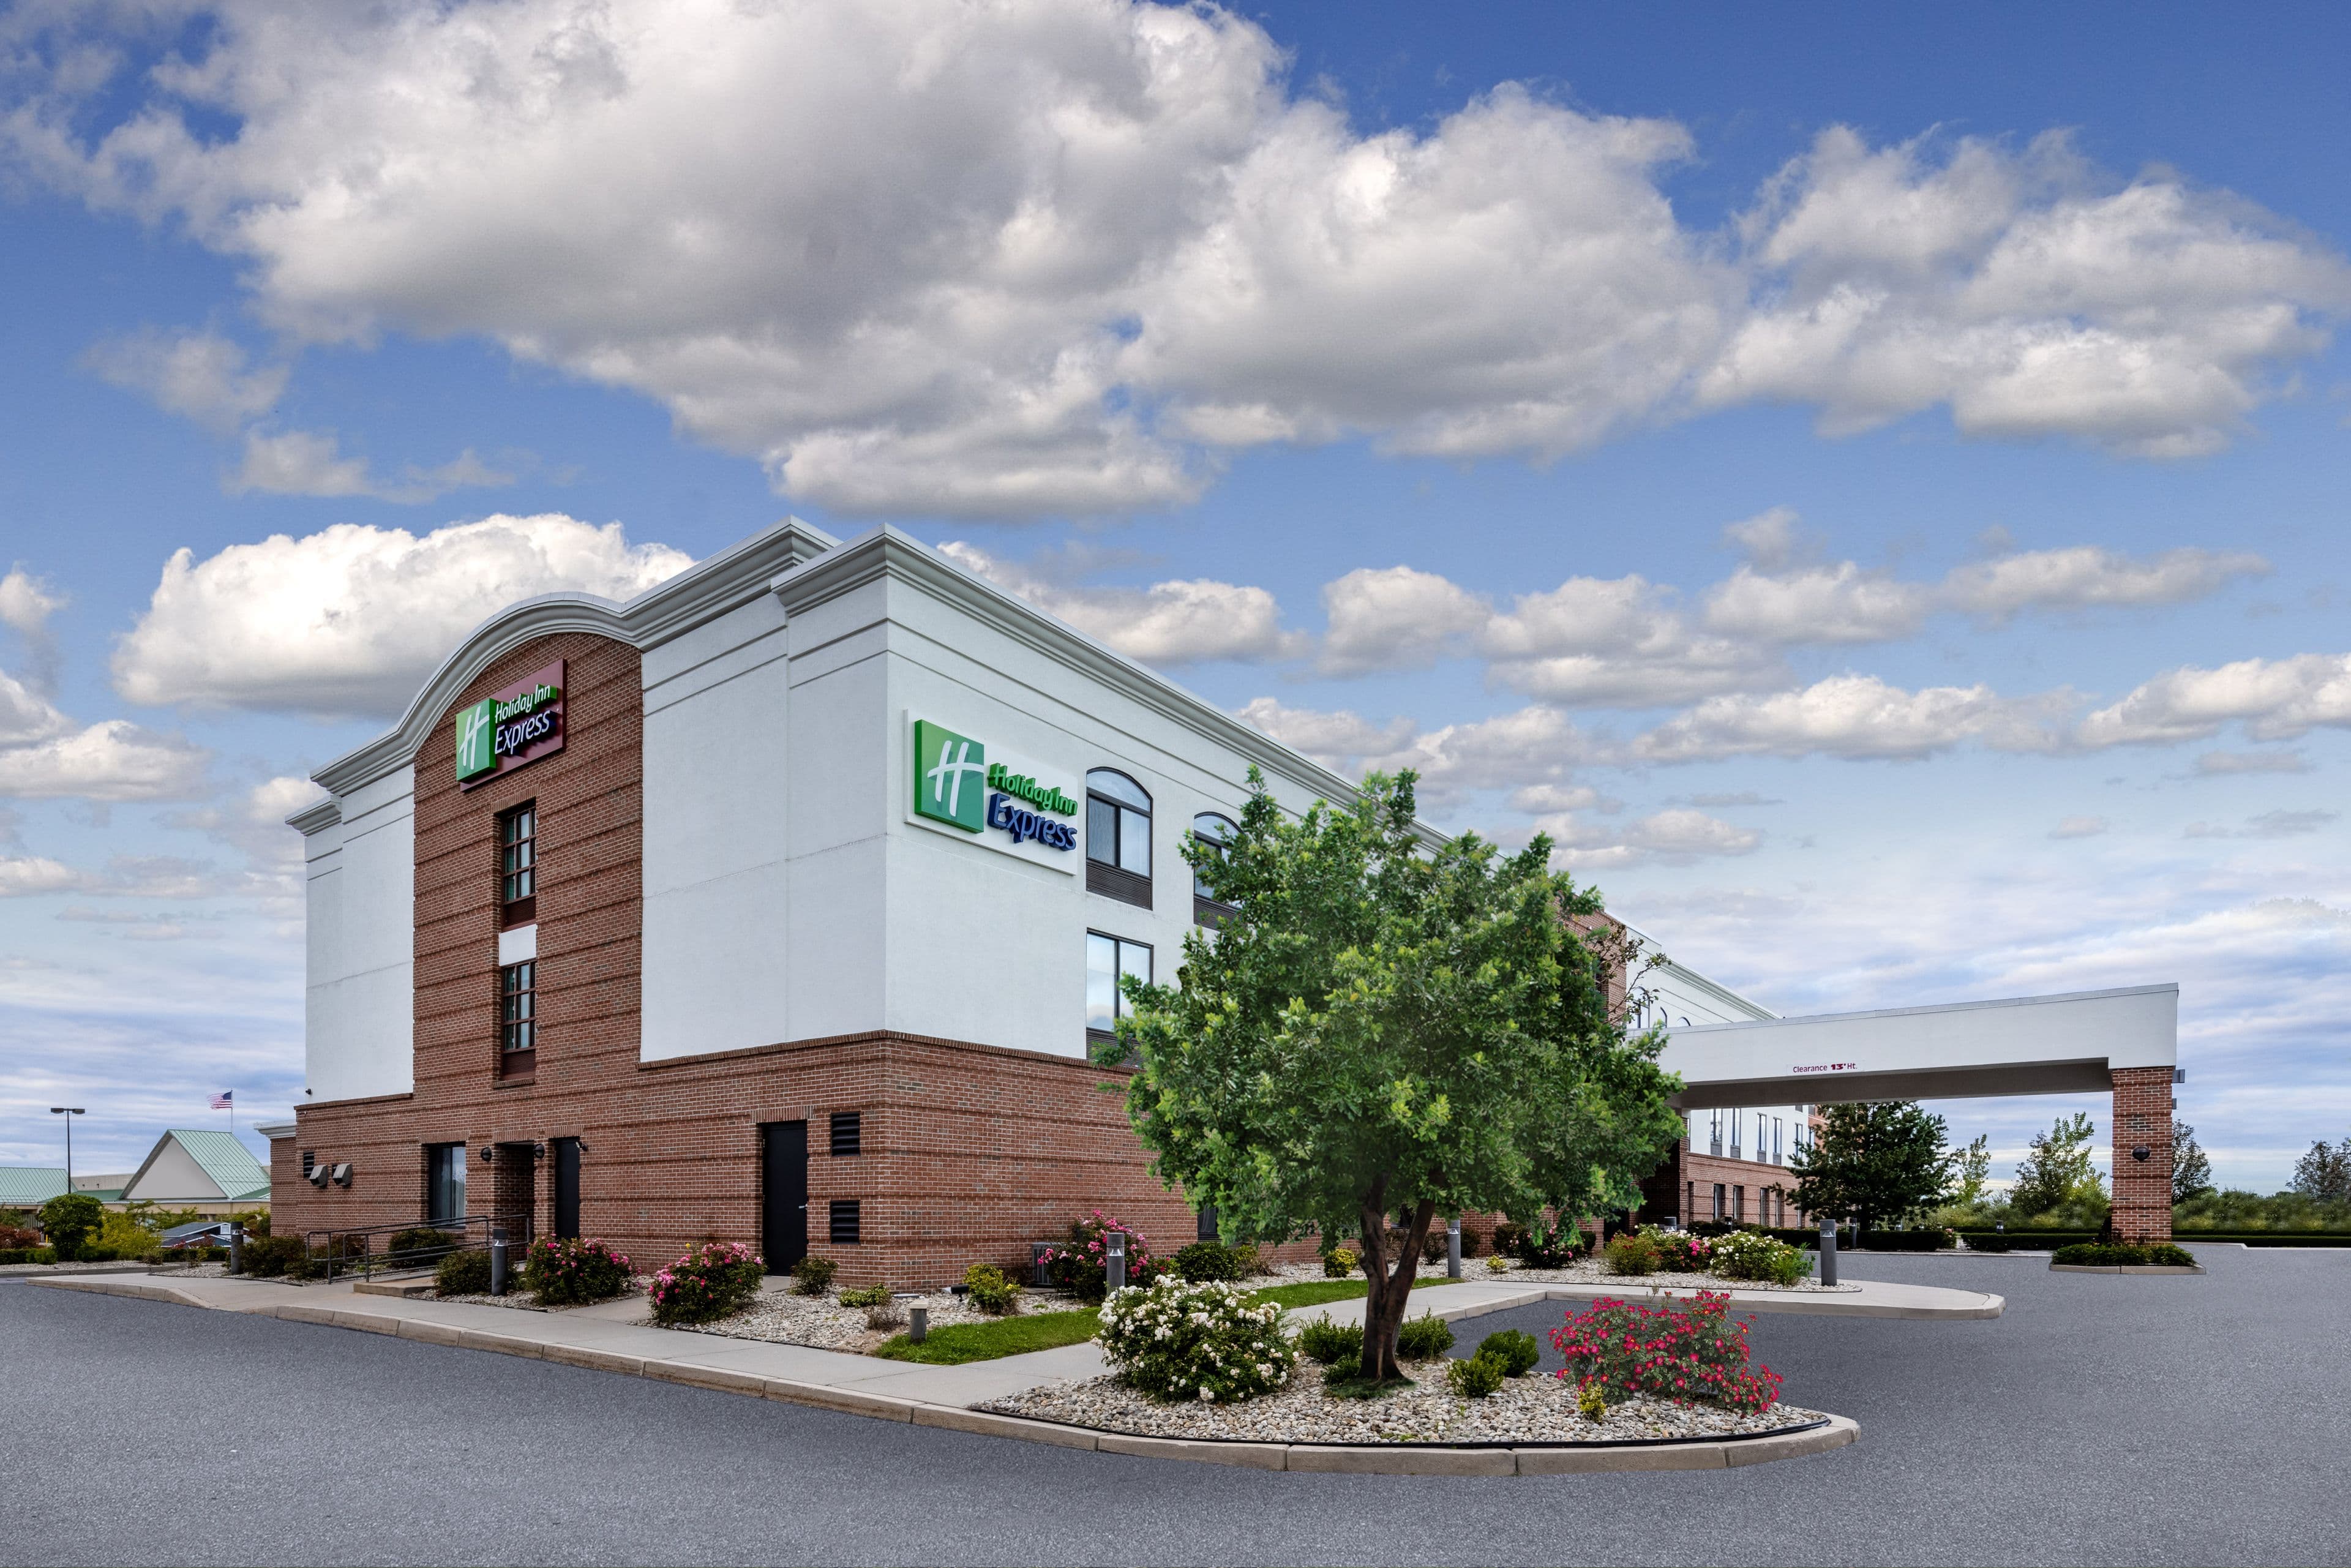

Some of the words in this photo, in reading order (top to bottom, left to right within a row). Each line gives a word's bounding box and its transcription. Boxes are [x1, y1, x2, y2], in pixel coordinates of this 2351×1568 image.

[495, 693, 533, 724] Holiday
[534, 684, 550, 704] Inn
[495, 710, 550, 755] Express
[988, 763, 1053, 811] Holiday
[1054, 787, 1078, 817] Inn
[987, 793, 1078, 851] Express
